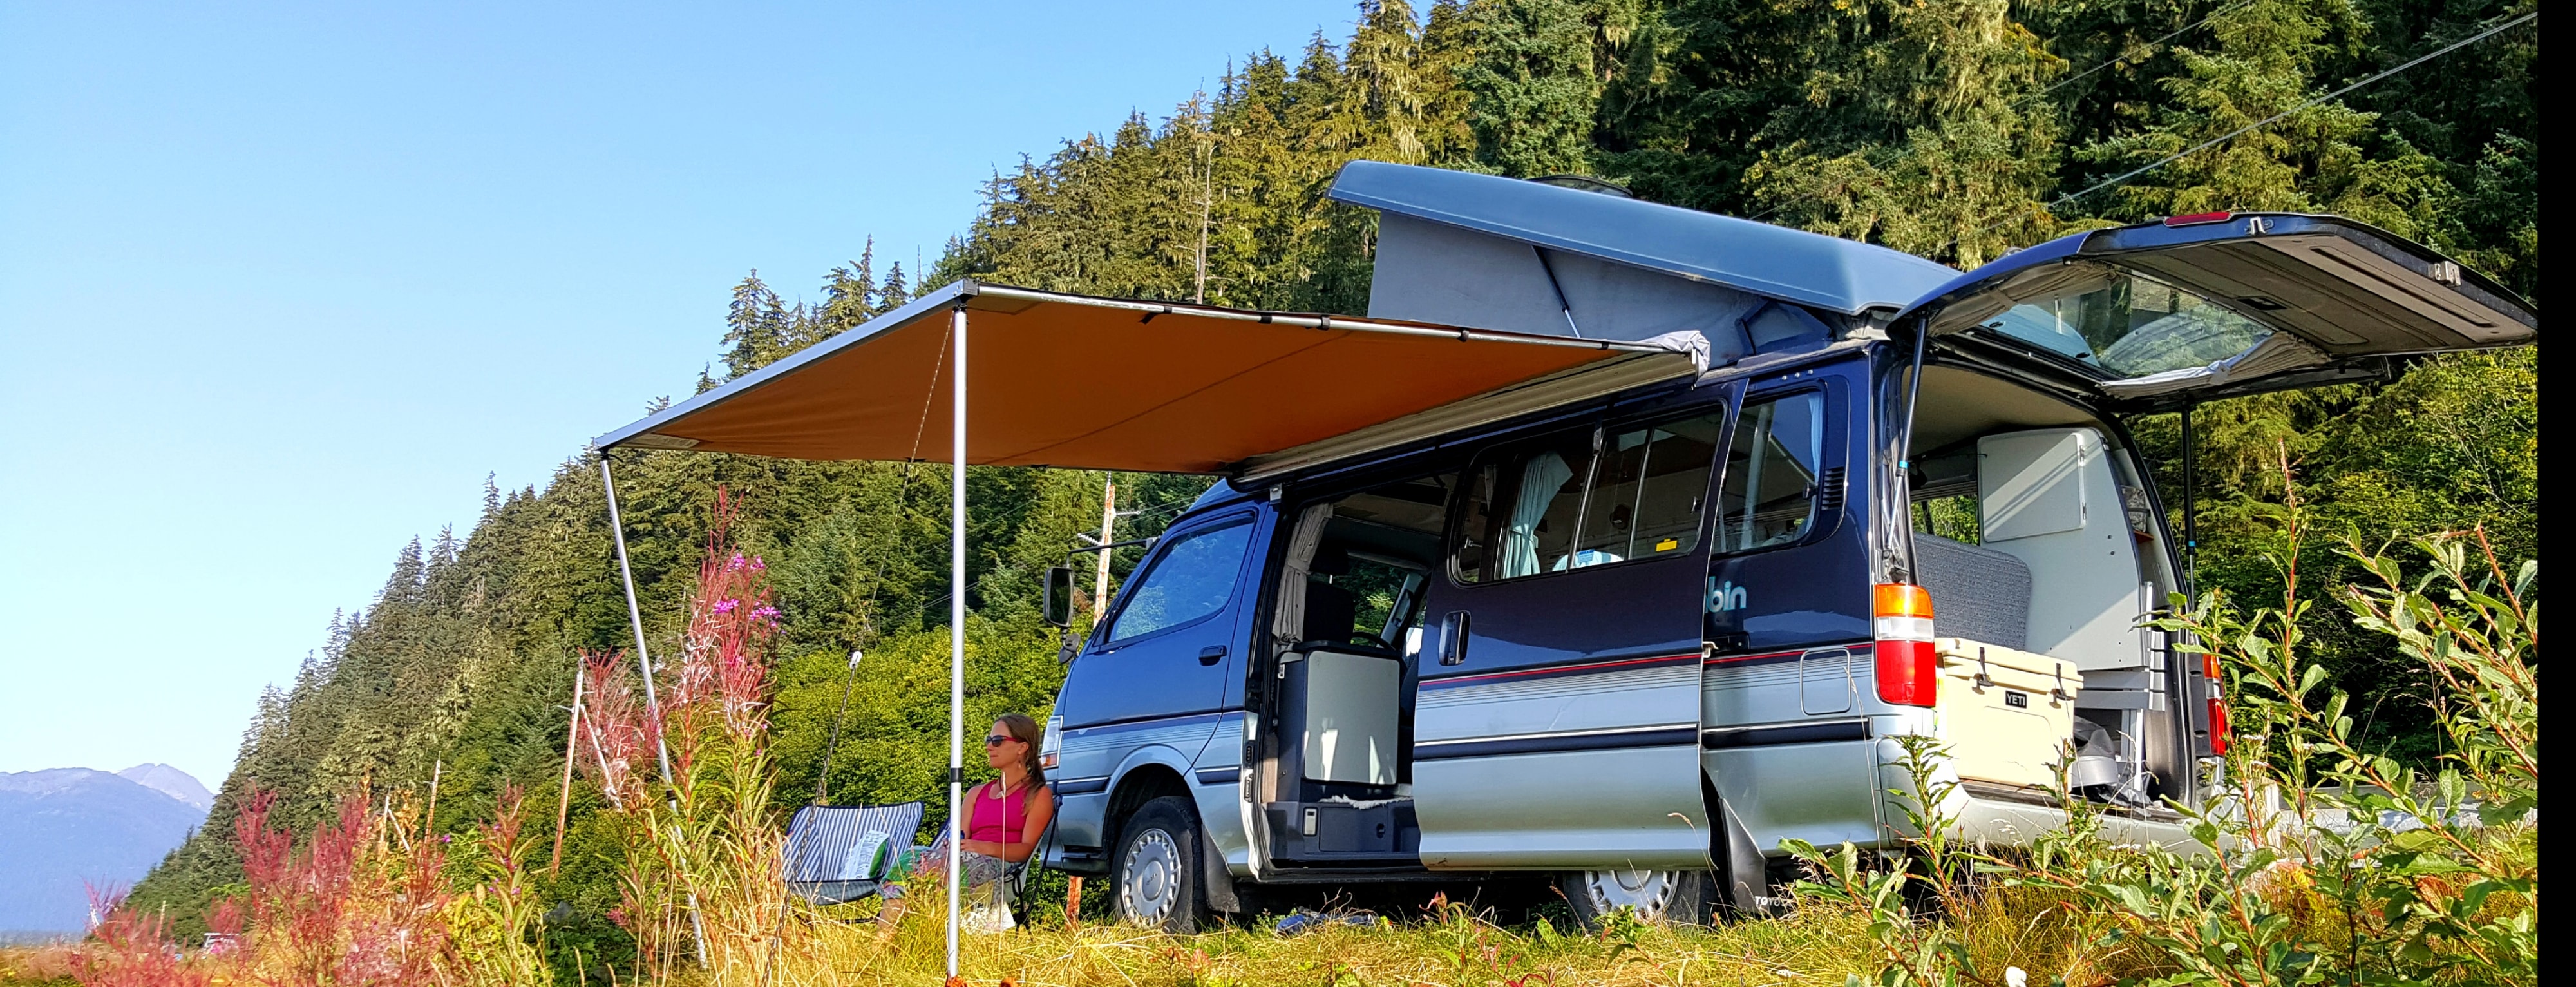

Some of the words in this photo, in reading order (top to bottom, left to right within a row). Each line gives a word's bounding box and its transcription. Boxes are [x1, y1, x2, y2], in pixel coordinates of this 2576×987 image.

[1705, 576, 1746, 613] bin
[2007, 693, 2025, 706] YETI
[1755, 896, 1792, 907] TOYO
